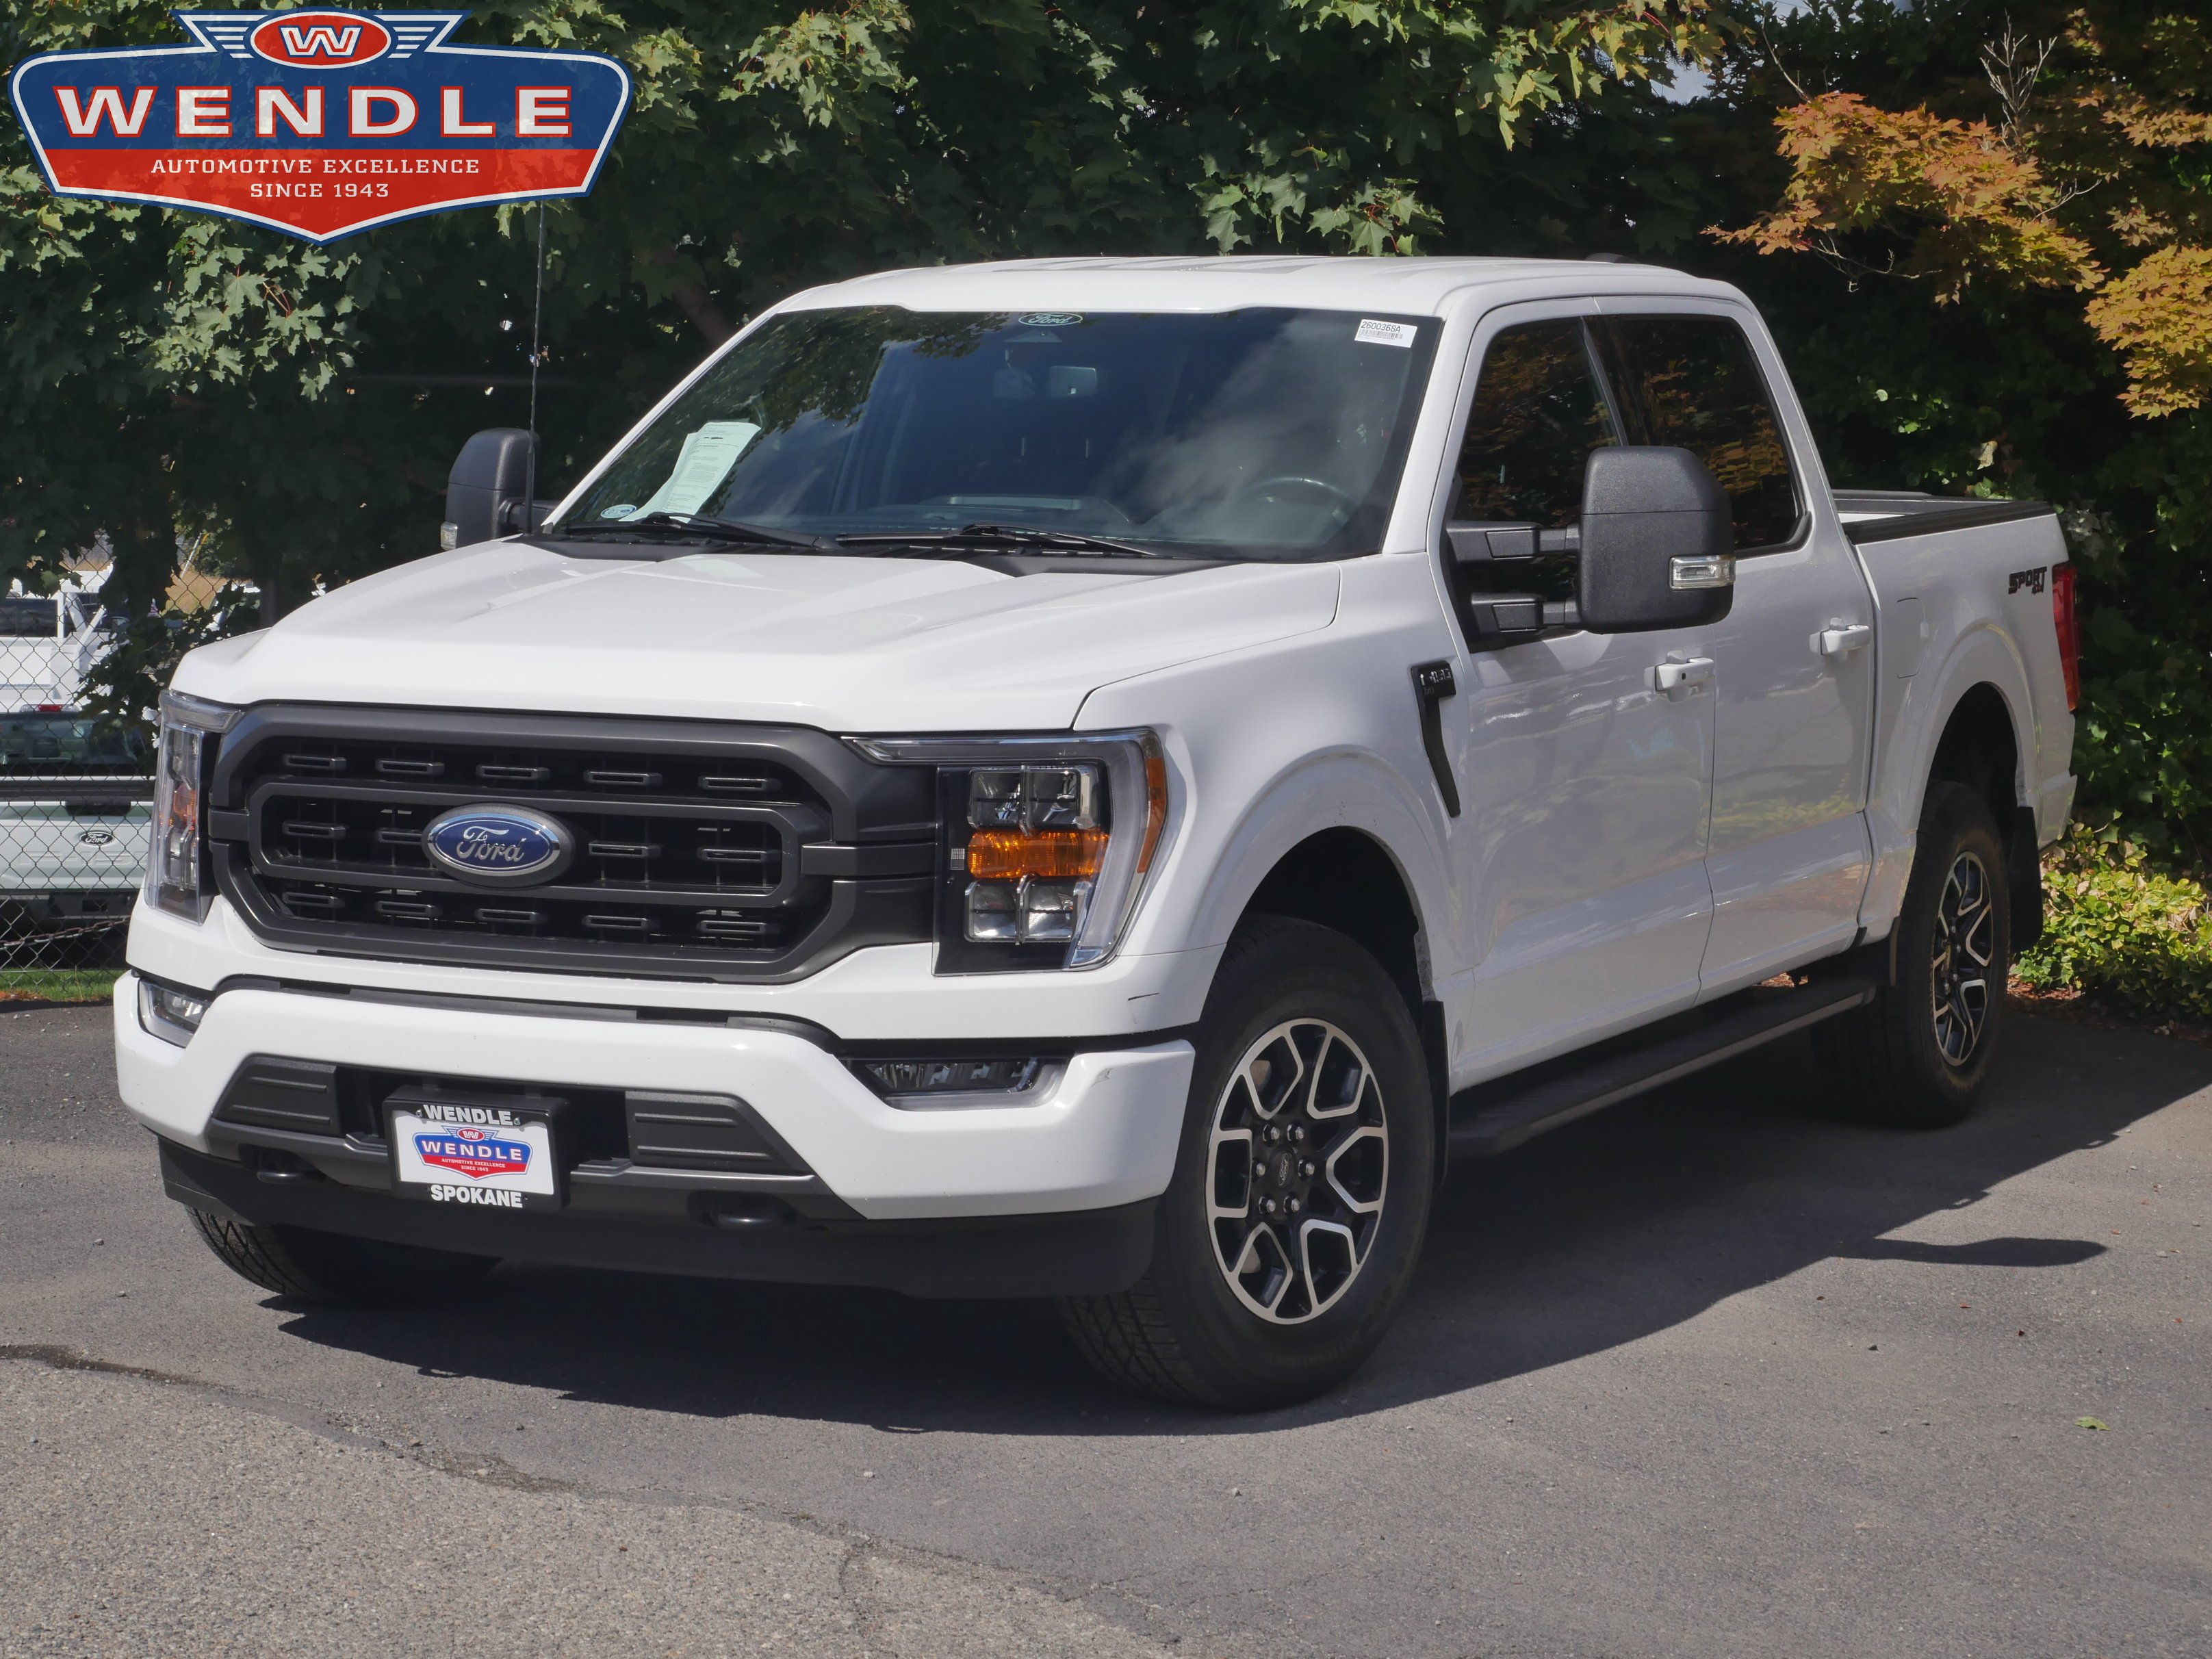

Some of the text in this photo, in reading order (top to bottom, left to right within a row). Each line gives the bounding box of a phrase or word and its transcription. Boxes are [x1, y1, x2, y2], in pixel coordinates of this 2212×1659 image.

[1028, 314, 1072, 324] Ford
[1361, 321, 1401, 333] 2600368A
[2008, 566, 2047, 595] SPORT
[456, 825, 526, 862] Ford
[423, 1104, 513, 1126] WENDLE
[421, 1140, 522, 1161] WENDLE
[430, 1185, 522, 1208] SPOKANE
